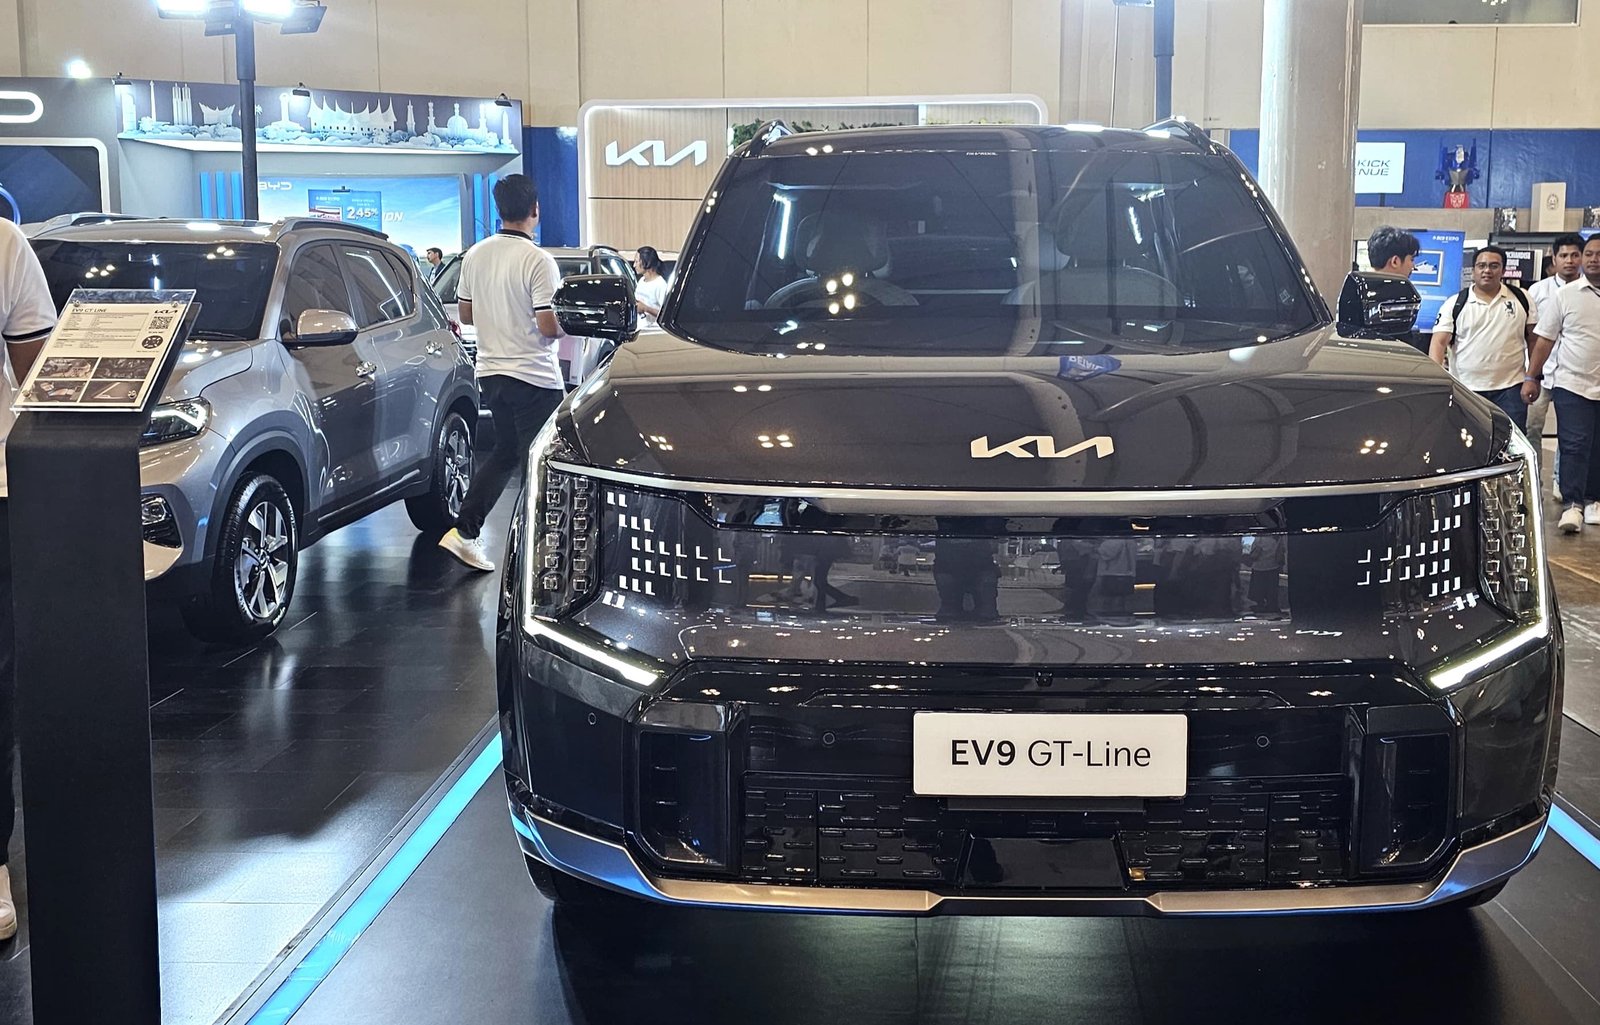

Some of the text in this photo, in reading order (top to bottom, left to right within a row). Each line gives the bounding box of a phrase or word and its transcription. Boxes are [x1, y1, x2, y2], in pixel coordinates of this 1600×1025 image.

[605, 139, 707, 167] KIA
[1357, 159, 1391, 168] KICK
[1355, 168, 1390, 176] NUE
[970, 435, 1115, 459] KIA
[951, 739, 1151, 767] EV9 GT-Line
